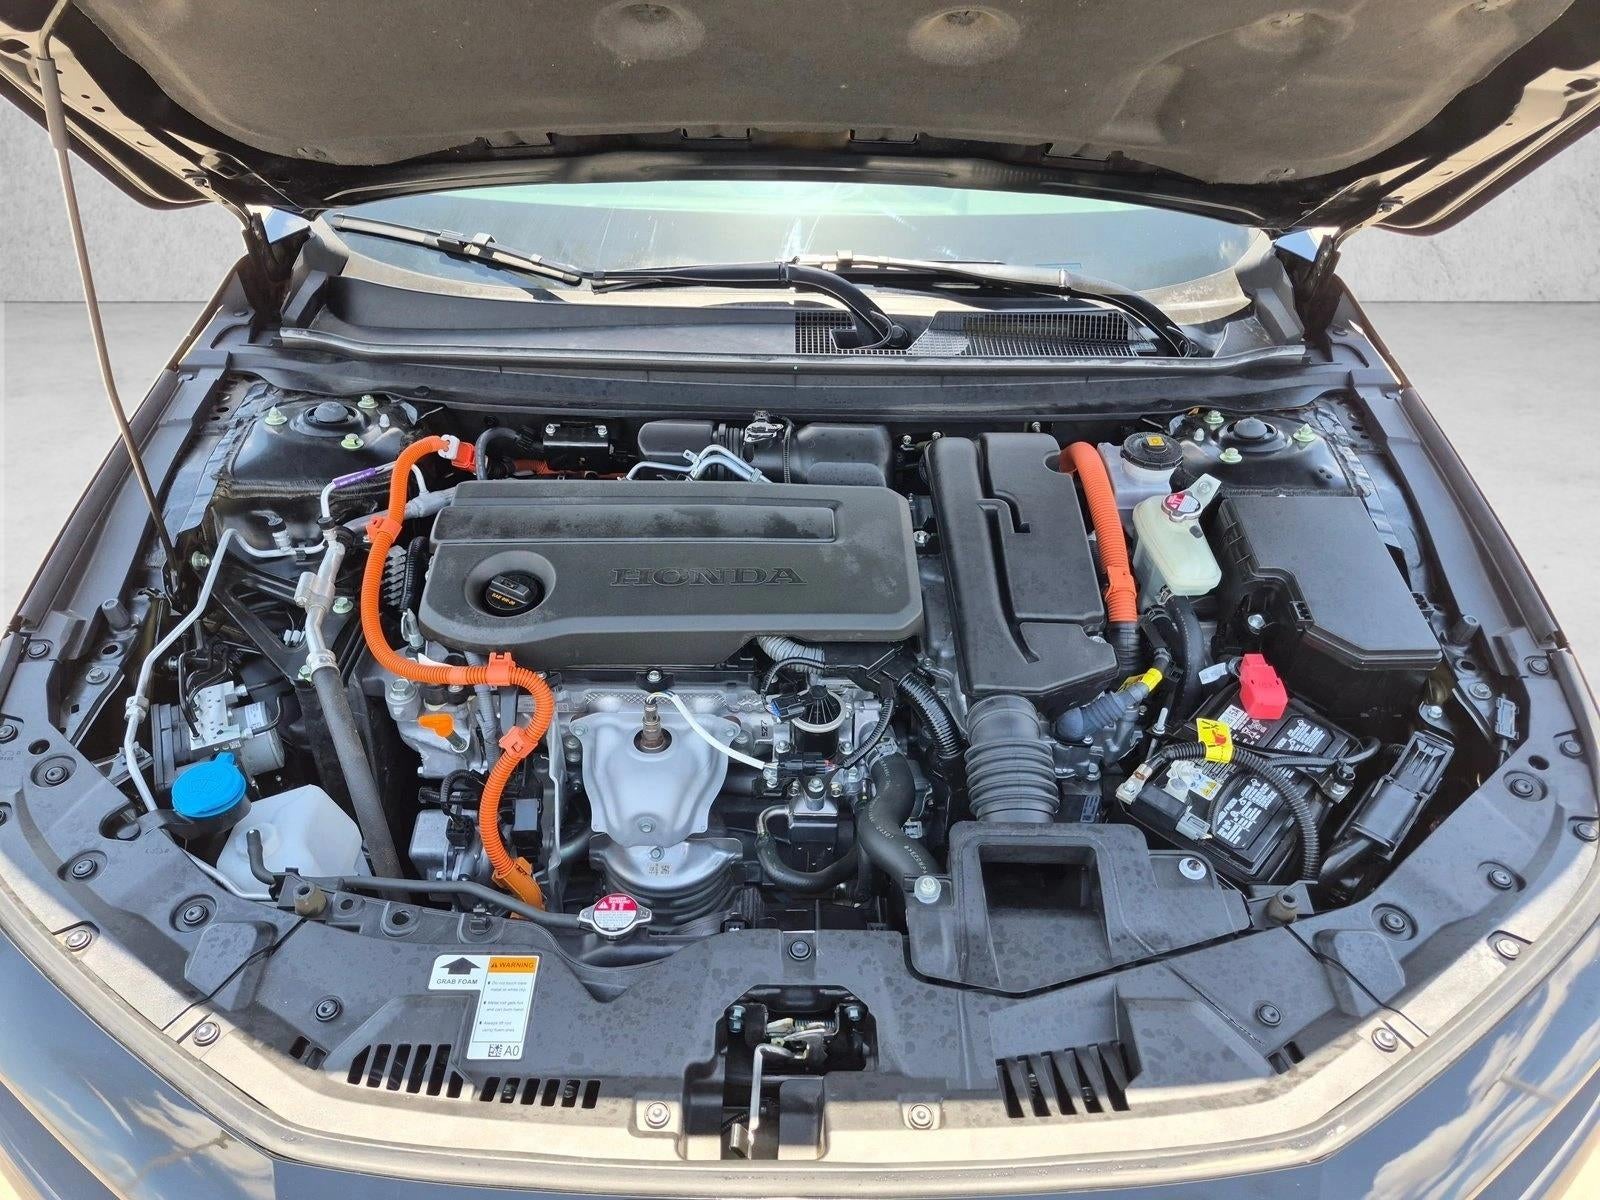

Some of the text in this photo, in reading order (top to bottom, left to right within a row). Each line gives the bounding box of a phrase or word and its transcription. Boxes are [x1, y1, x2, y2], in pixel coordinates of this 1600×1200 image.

[610, 567, 808, 587] HONDA
[760, 719, 769, 737] 527
[504, 1045, 519, 1056] A0
